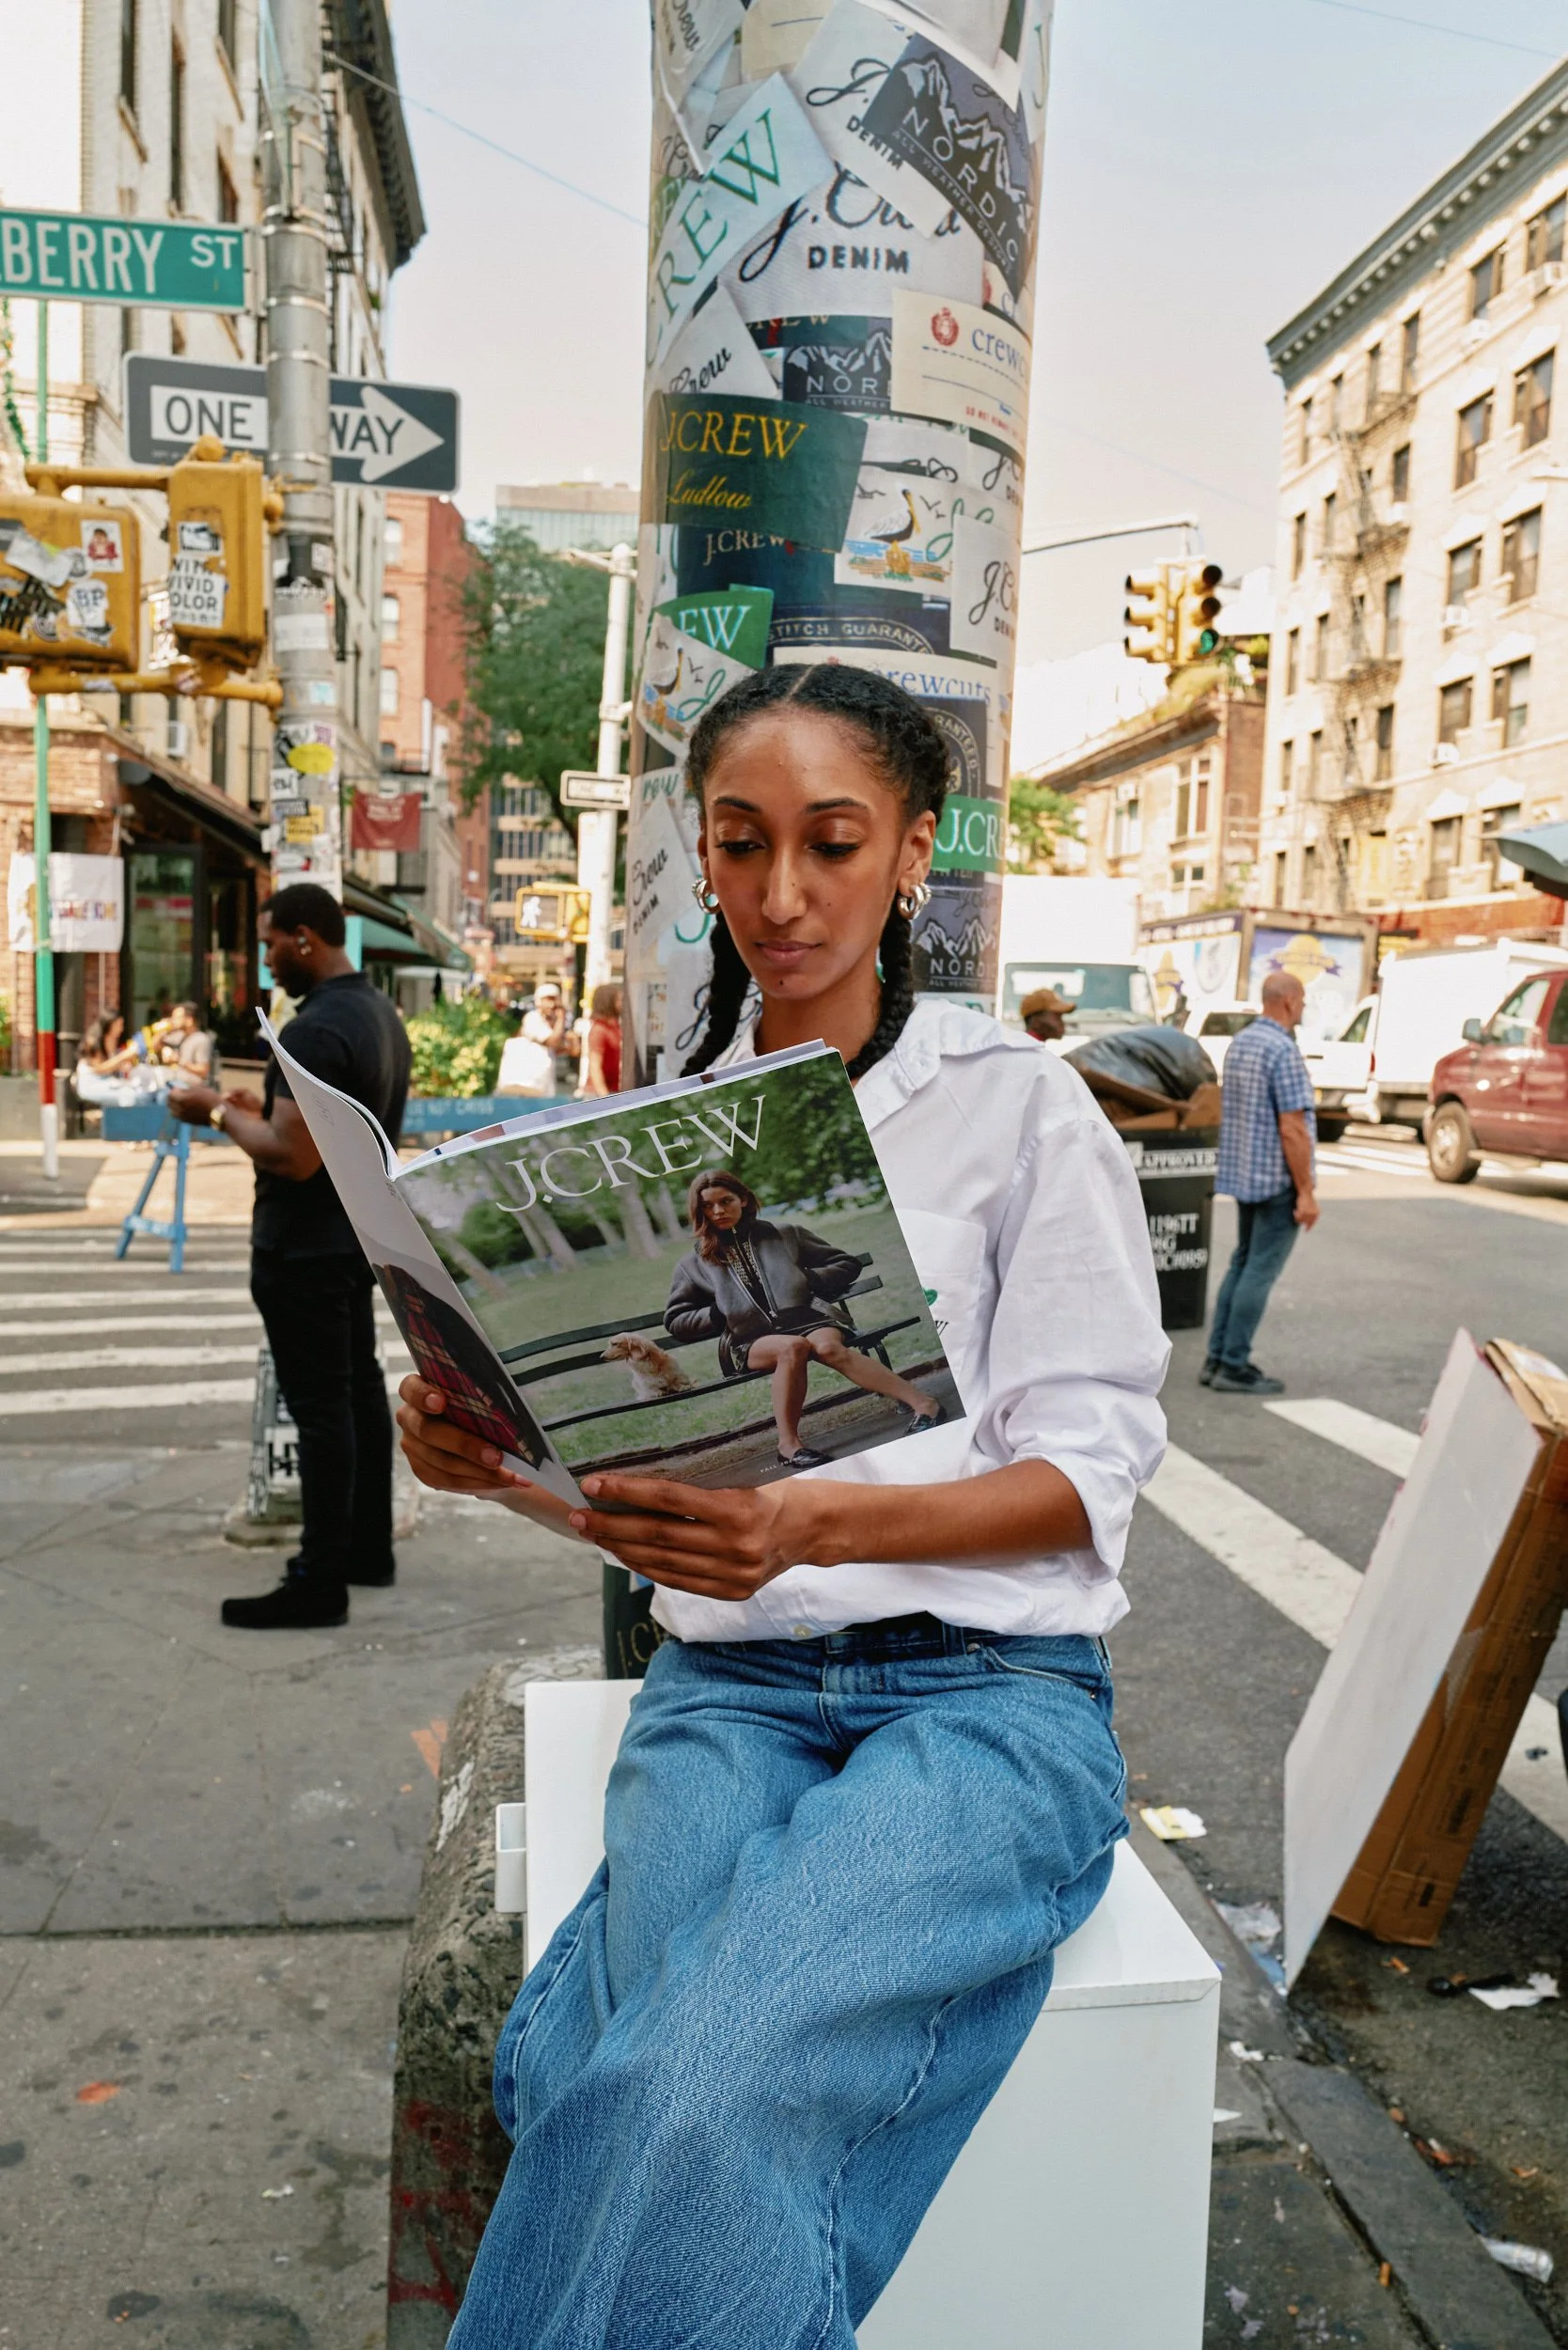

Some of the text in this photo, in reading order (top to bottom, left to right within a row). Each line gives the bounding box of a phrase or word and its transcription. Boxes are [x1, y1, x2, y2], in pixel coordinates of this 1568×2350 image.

[847, 115, 905, 171] DENIM
[902, 106, 1019, 261] NORDIC
[190, 234, 239, 270] ST
[808, 245, 910, 274] DENIM
[807, 376, 891, 396] NOR
[165, 395, 254, 441] ONE
[666, 469, 751, 509] Ludlow
[703, 530, 786, 566] J.CREW
[871, 665, 991, 707] rewcuts
[494, 1094, 766, 1214] J.CREW
